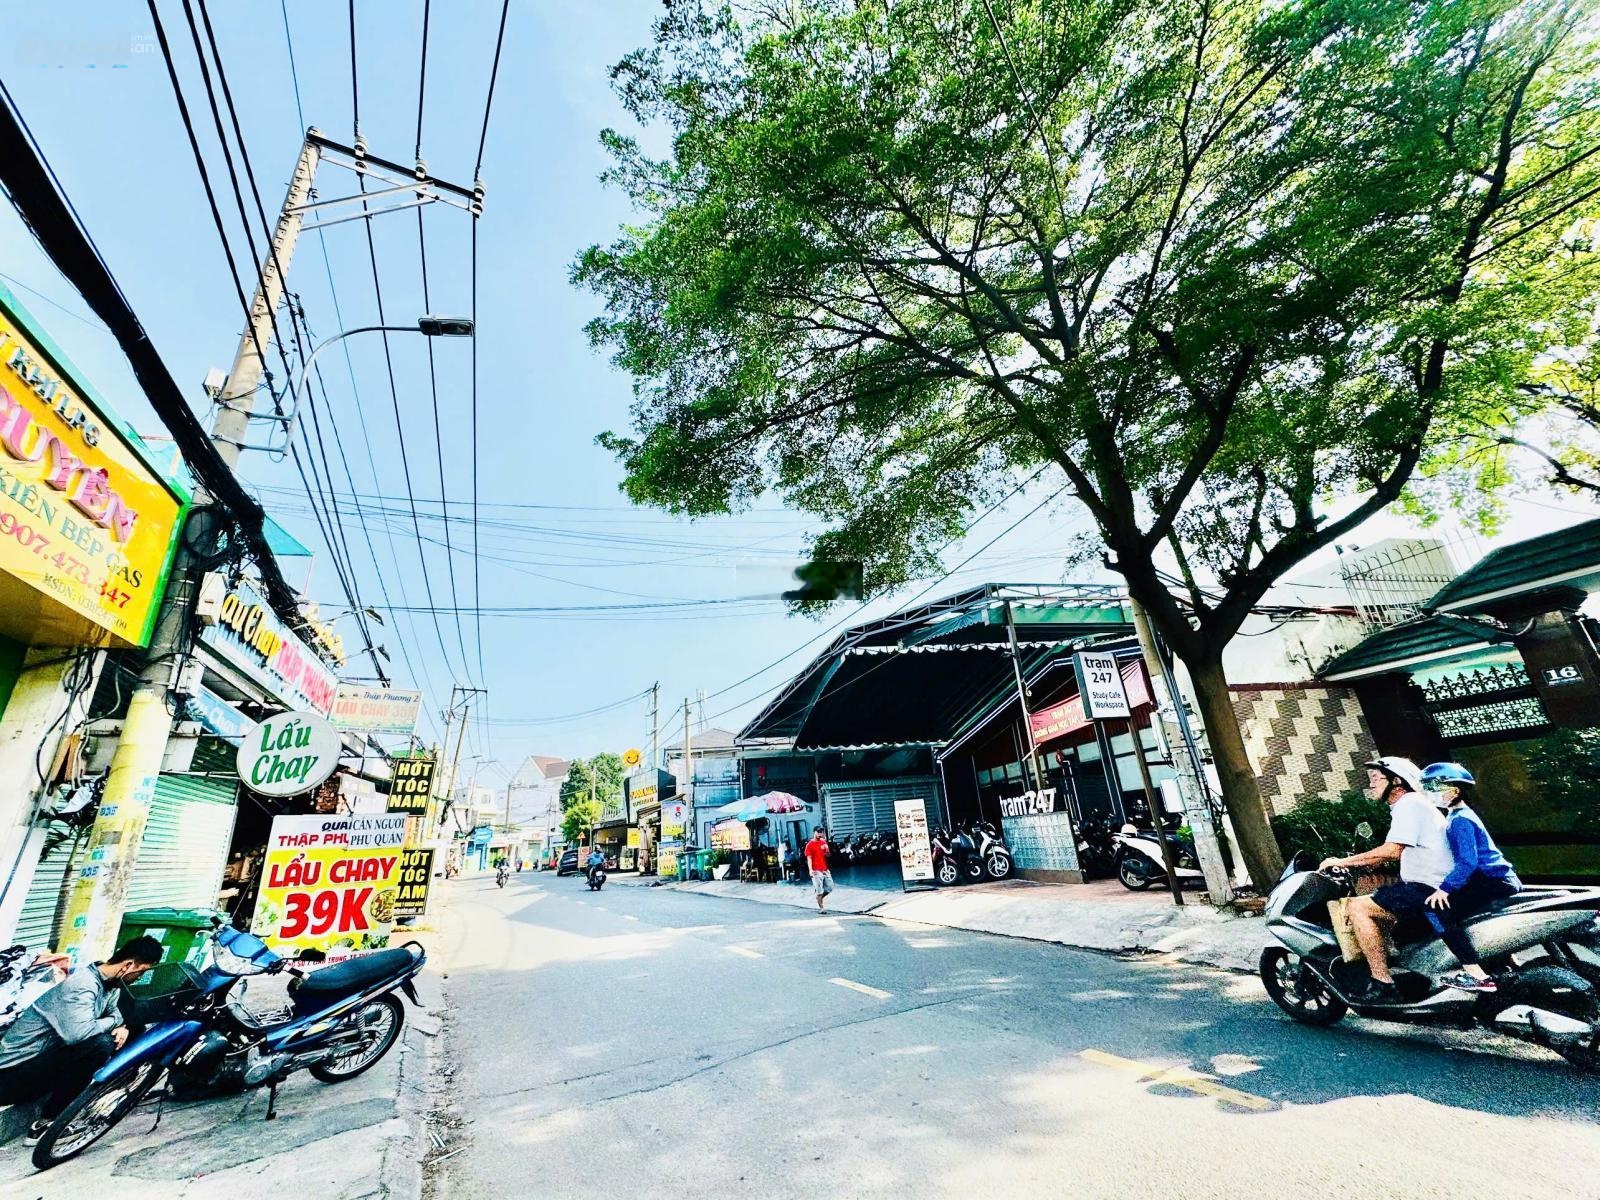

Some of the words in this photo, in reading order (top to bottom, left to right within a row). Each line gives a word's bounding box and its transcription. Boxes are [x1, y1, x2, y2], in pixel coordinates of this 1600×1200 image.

[54, 392, 100, 448] LPG
[104, 552, 143, 589] GAS
[1091, 672, 1113, 684] 247
[1546, 665, 1579, 681] 16
[1092, 691, 1108, 700] Study
[1094, 701, 1125, 709] Workspace
[260, 718, 312, 753] Lẩu
[251, 754, 319, 785] Chay
[397, 760, 433, 777] HỚT
[396, 776, 429, 793] TÓC
[389, 794, 428, 808] NAM
[278, 832, 319, 848] THẬP
[268, 853, 321, 888] LẨU
[329, 857, 398, 884] CHAY
[280, 887, 373, 939] 39K
